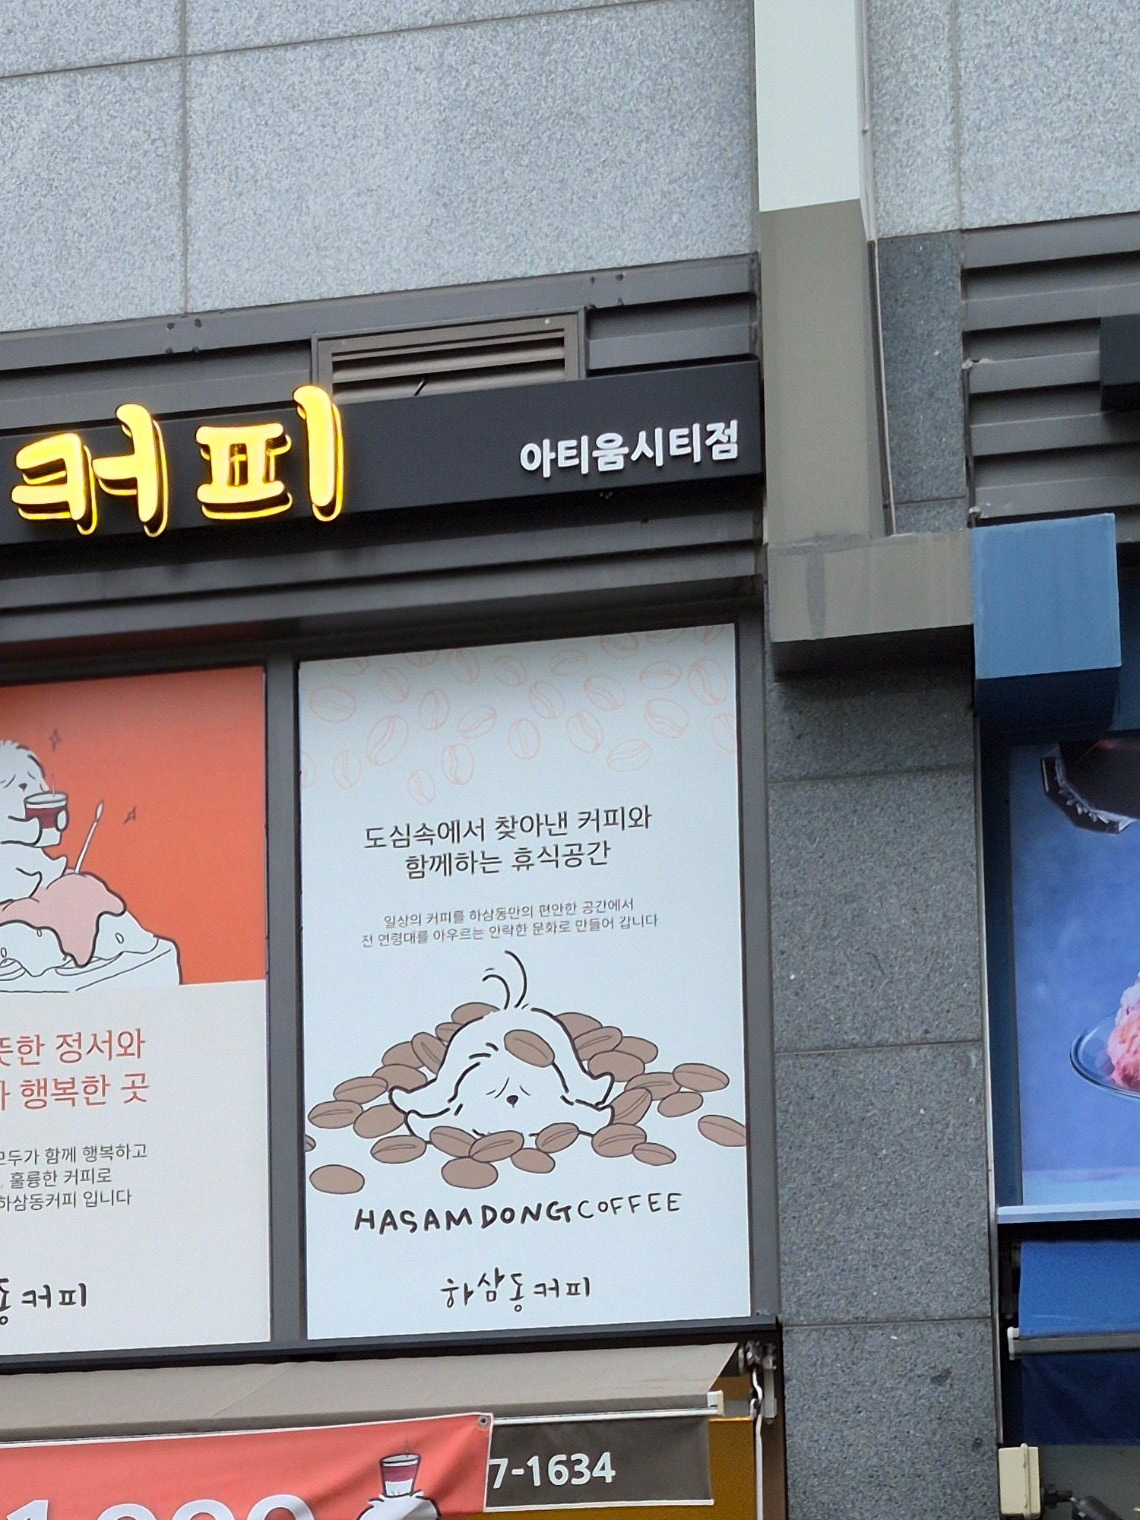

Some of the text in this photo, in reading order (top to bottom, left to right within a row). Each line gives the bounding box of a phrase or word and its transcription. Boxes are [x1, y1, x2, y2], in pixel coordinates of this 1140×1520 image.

[519, 419, 738, 478] 아티움시티점
[363, 804, 653, 850] 도심속에서 찾아낸 커피와
[405, 839, 612, 880] 함께하는 휴식공간
[383, 913, 422, 929] 일상의
[426, 910, 465, 926] 커피를
[581, 897, 635, 914] 공간에서
[432, 927, 485, 942] 아우르는
[532, 919, 571, 936] 문화로
[575, 916, 615, 933] 만들어
[619, 913, 659, 930] 갑니다
[55, 1027, 146, 1064] 정서와
[19, 1074, 110, 1110] 행복한
[120, 1072, 150, 1104] 곳
[44, 1146, 77, 1164] 함께
[82, 1143, 148, 1162] 행복하고
[9, 1169, 58, 1189] 훌륭한
[63, 1167, 113, 1185] 커피로
[83, 1188, 132, 1208] 입니다
